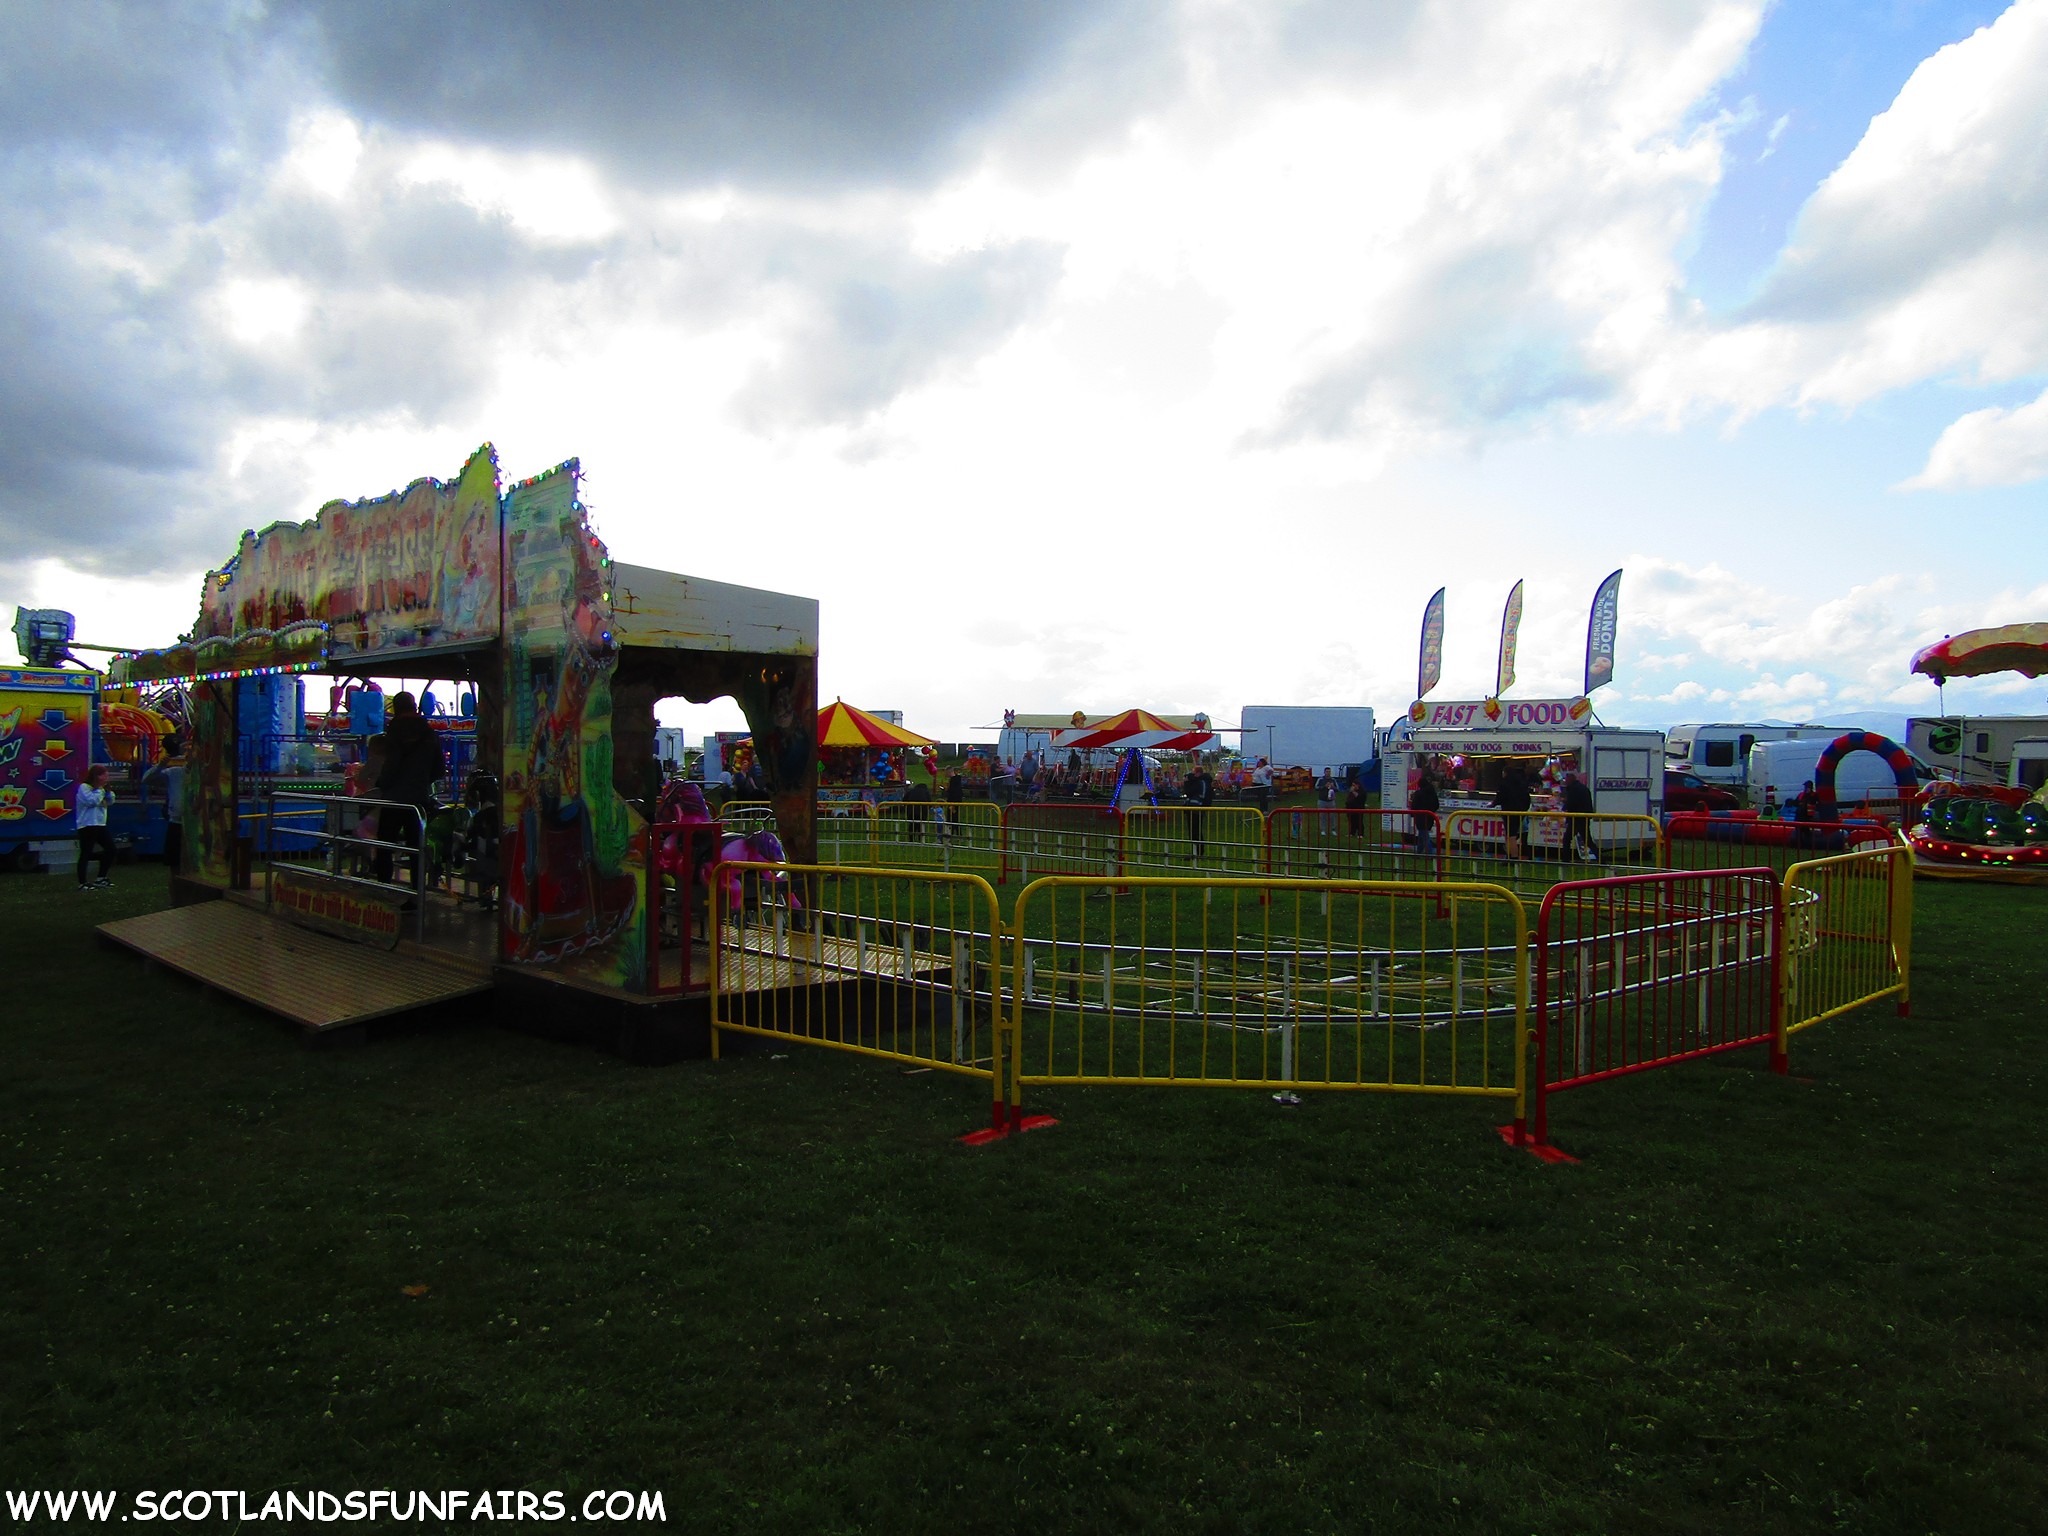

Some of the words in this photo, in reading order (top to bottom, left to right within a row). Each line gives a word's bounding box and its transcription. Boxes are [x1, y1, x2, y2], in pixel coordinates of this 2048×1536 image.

[1595, 597, 1605, 618] MADE
[1600, 589, 1615, 654] DONUTS
[1592, 619, 1601, 650] FRESHLY
[1431, 704, 1478, 725] FAST
[1507, 703, 1567, 725] FOOD
[1396, 743, 1415, 751] CHIPS
[1423, 743, 1454, 751] BURGERS
[1463, 743, 1478, 751] HOT
[1480, 743, 1502, 752] DOGS
[1512, 743, 1542, 752] DRINKS
